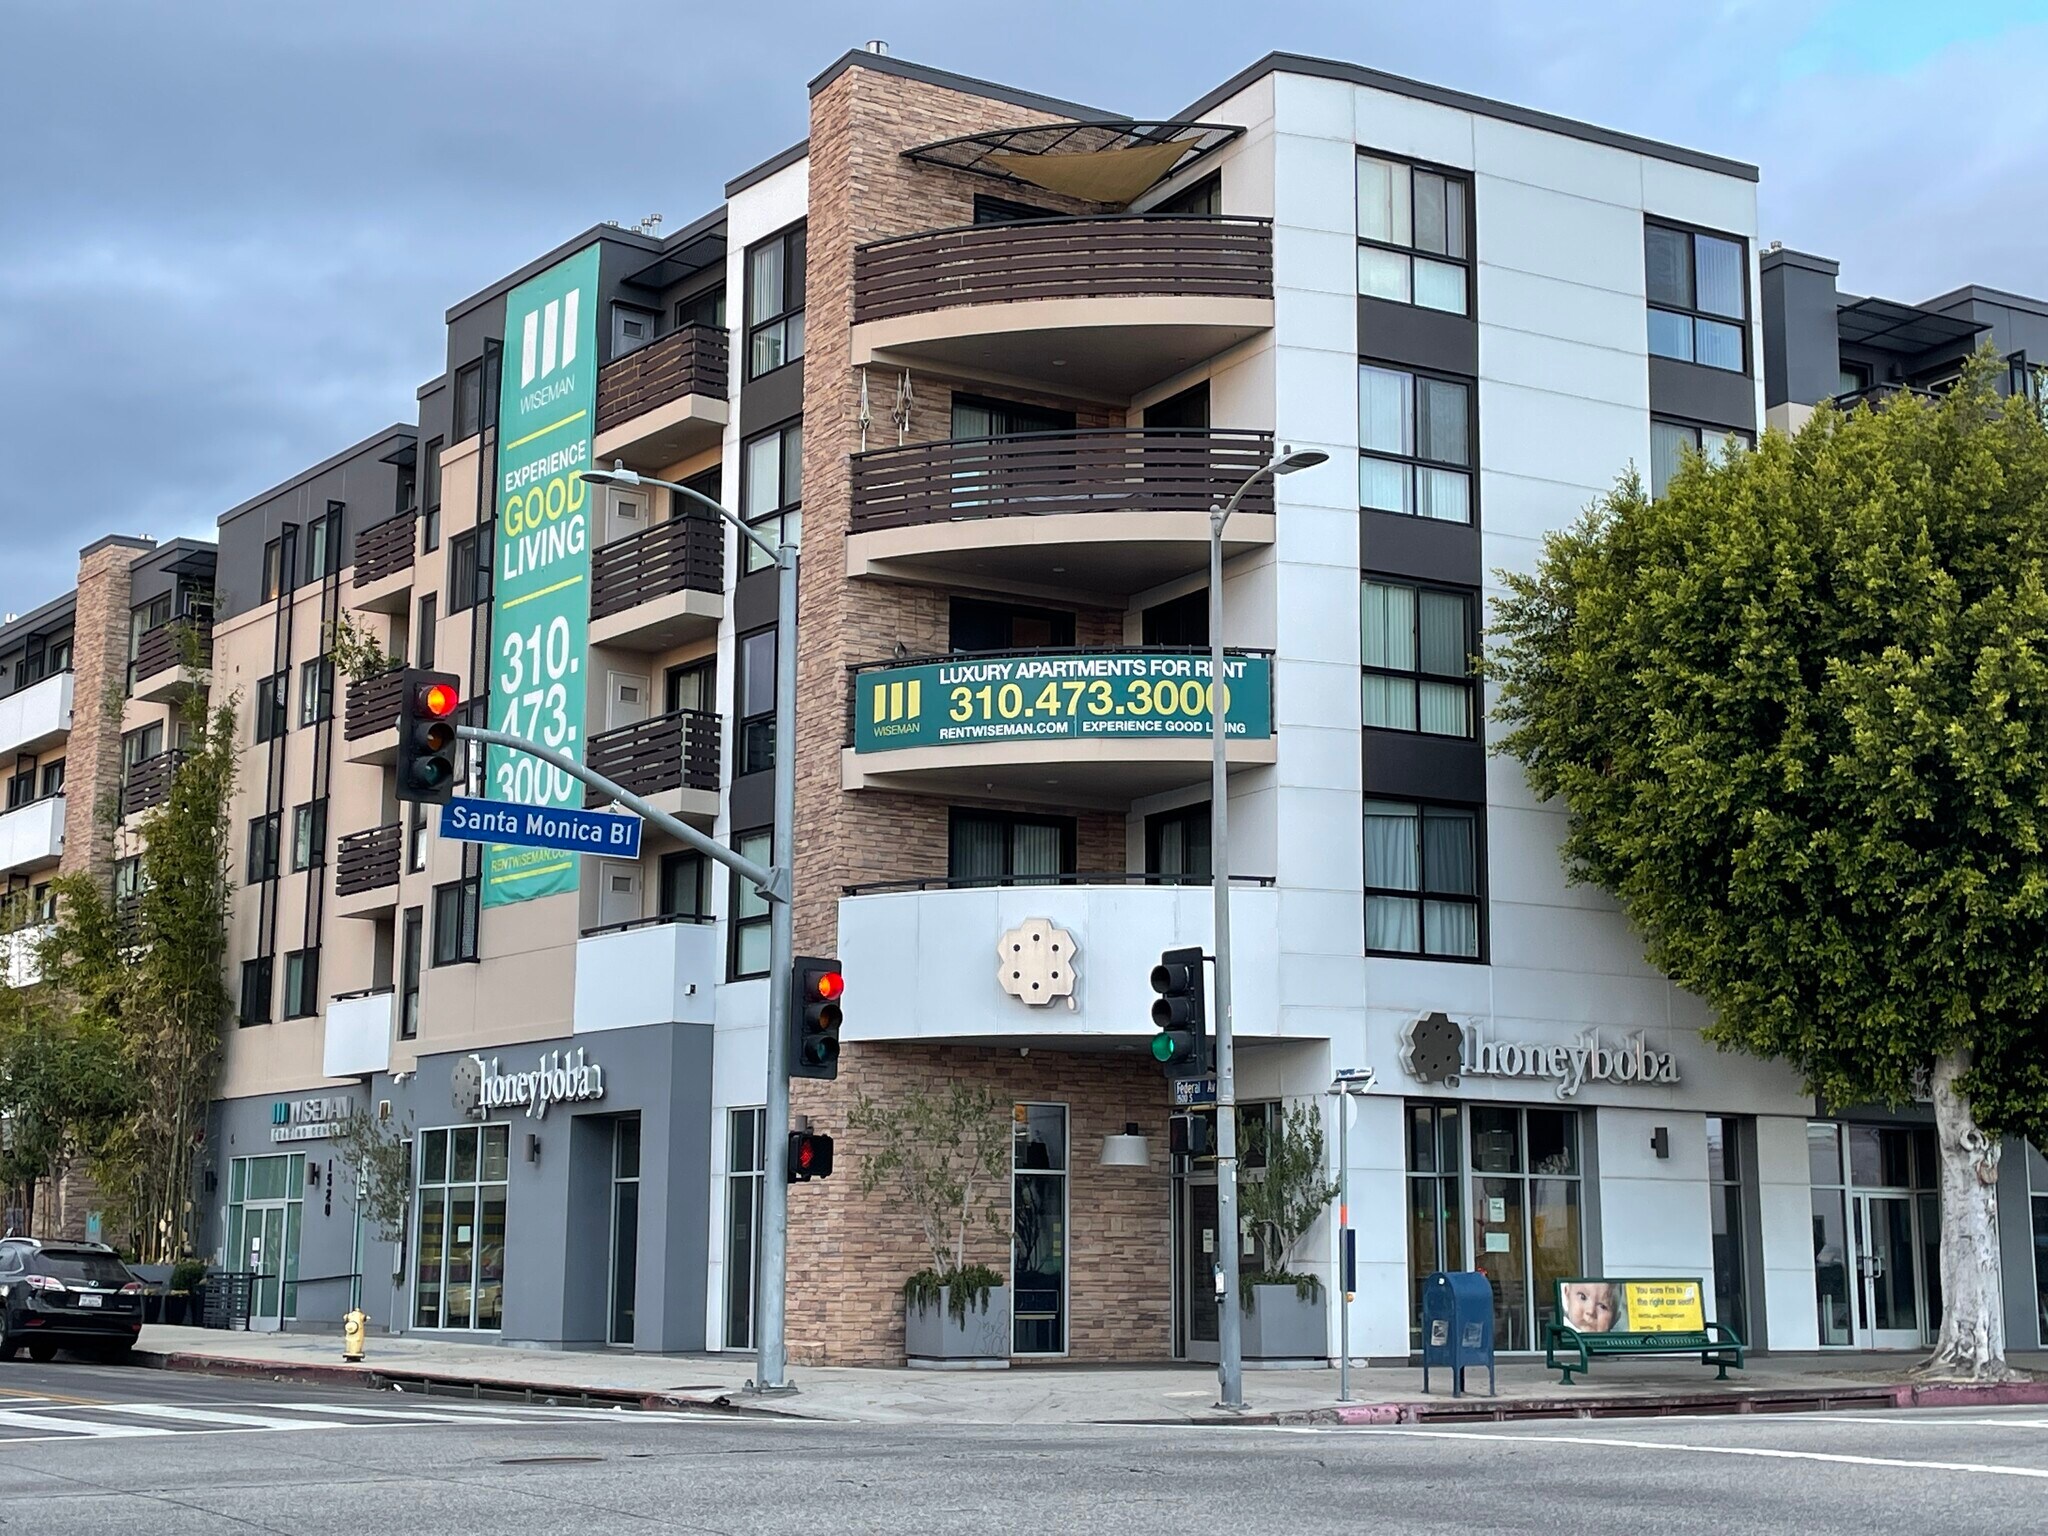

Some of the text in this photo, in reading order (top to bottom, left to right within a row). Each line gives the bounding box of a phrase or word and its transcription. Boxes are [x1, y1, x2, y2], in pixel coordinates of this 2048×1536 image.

[520, 375, 575, 415] WISEMAN
[505, 439, 587, 493] EXPERIENCE
[504, 469, 586, 538] GOOD
[503, 514, 585, 581] LIVING
[501, 615, 579, 694] 310.
[939, 659, 1247, 685] LUXURY APARTMENTS FOR RNT
[498, 683, 577, 758] 473.
[949, 679, 1231, 722] 310.473.3000
[873, 722, 920, 738] WISEMAN
[939, 720, 1246, 740] RENTWISEMAN.COM EXPERIENCE GOOD LING
[496, 746, 575, 806] 3000
[451, 805, 632, 846] Santa Monica Bl
[1461, 1016, 1681, 1100] honeyboba
[478, 1047, 603, 1120] honeyboba
[1176, 1081, 1200, 1094] Federal
[290, 1096, 353, 1123] WISEMAN
[1636, 1286, 1648, 1294] You
